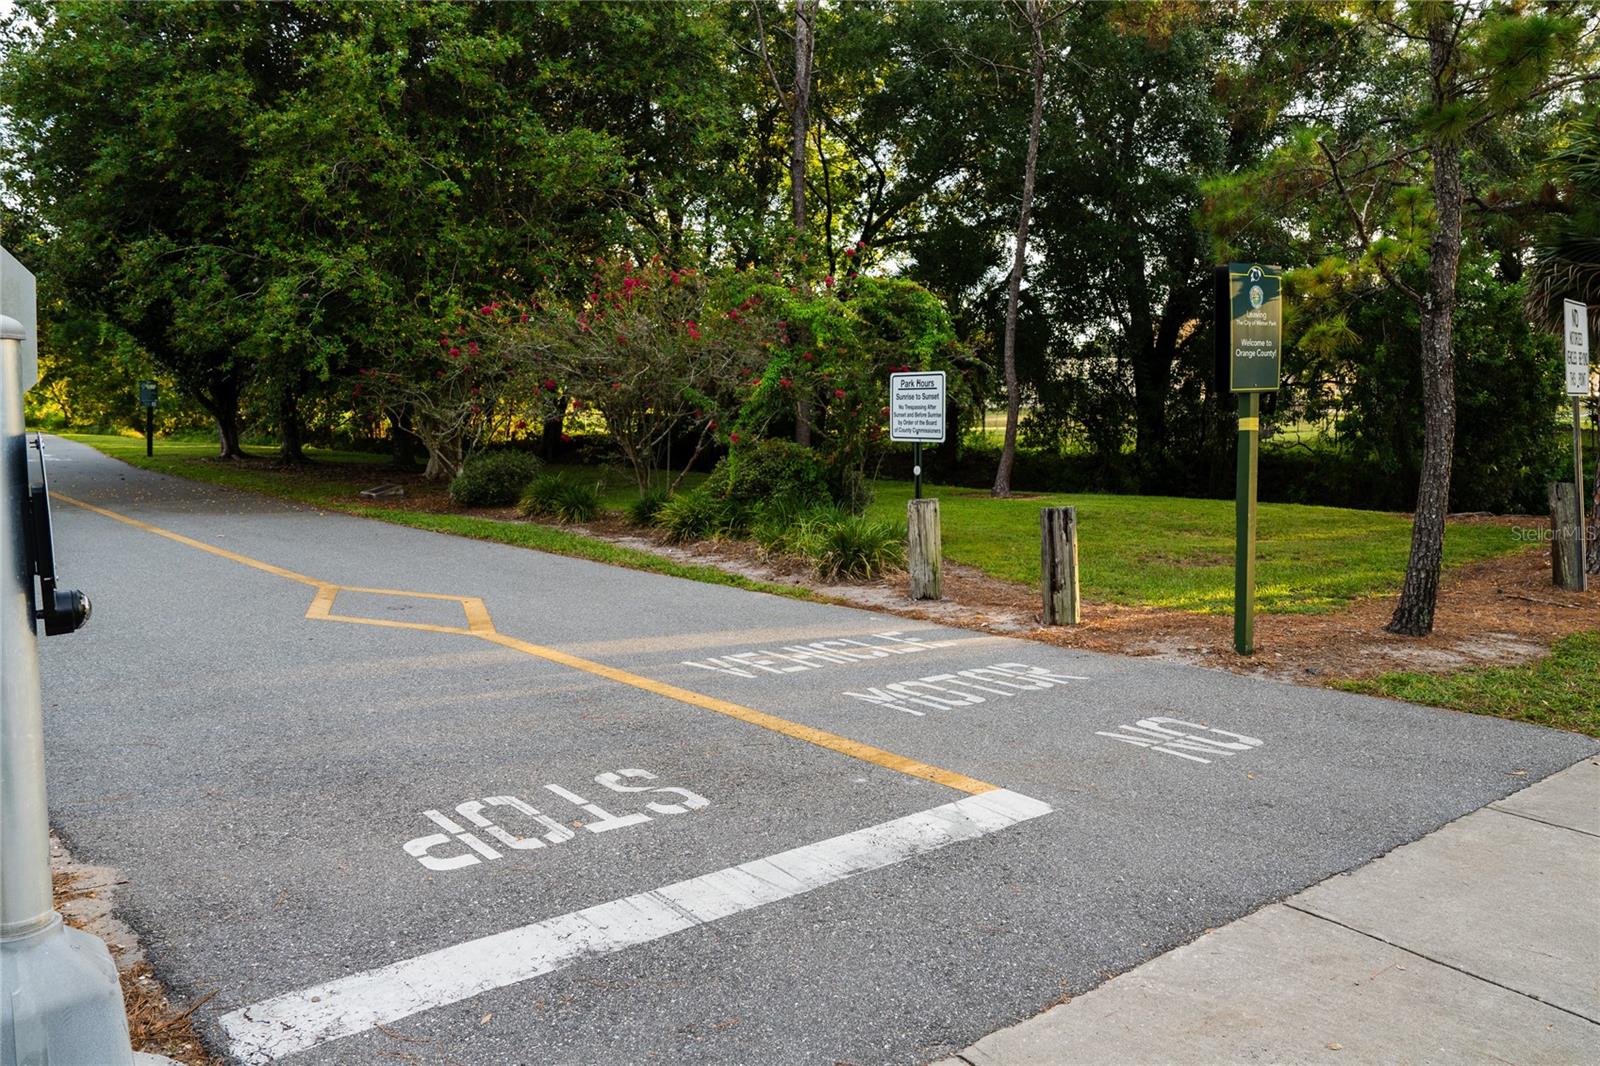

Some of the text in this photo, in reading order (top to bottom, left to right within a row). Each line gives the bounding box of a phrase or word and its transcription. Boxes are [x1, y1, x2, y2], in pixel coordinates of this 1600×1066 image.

[1246, 310, 1267, 320] Leaving
[1241, 338, 1265, 347] Welcome
[1235, 348, 1256, 359] Orange
[900, 379, 935, 388] Park Hours
[896, 393, 914, 401] Sunrise
[922, 392, 940, 400] Sunset
[681, 630, 960, 679] VEHICLE
[842, 661, 1090, 717] MOTOR
[1094, 716, 1264, 764] NO
[402, 768, 711, 872] STOP
